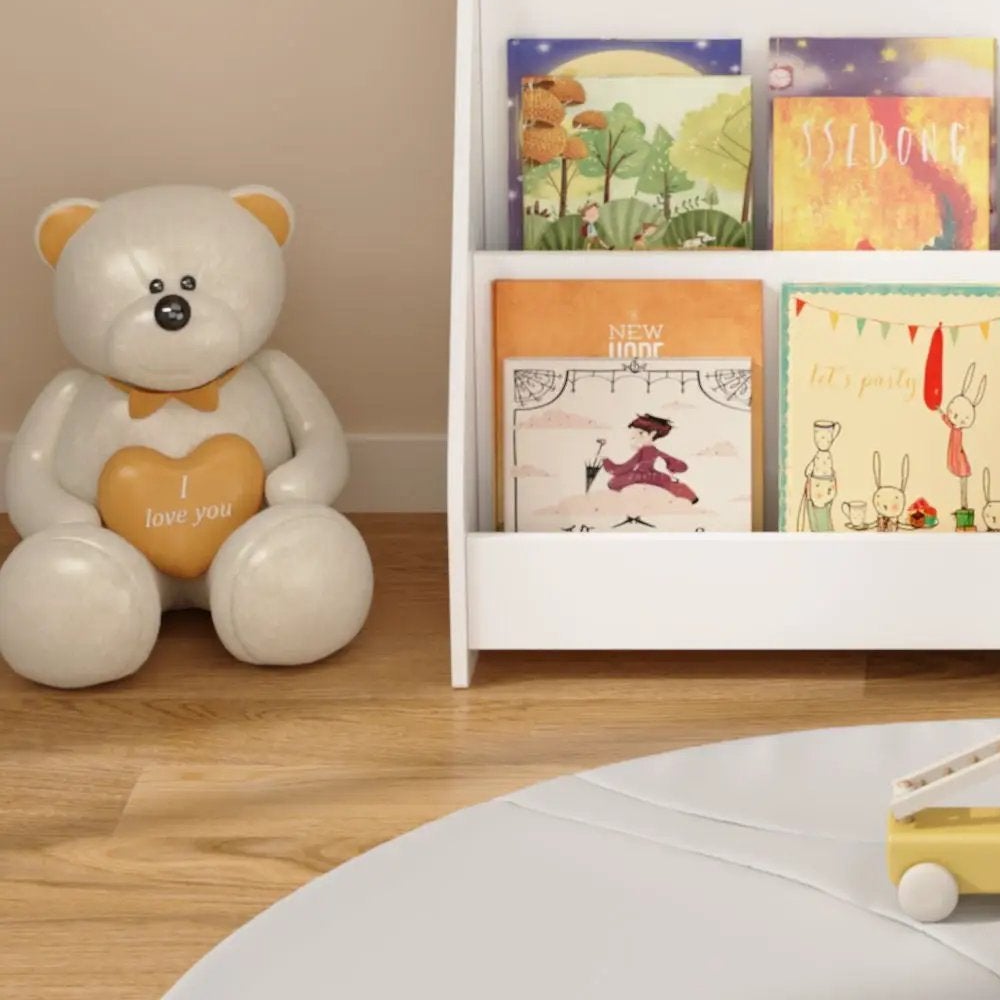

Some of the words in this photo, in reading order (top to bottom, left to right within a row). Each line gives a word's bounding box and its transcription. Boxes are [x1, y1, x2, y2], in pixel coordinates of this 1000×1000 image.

[607, 324, 665, 340] NEW
[857, 364, 918, 402] party
[179, 475, 188, 500] I
[145, 508, 189, 529] love
[192, 502, 233, 528] you
